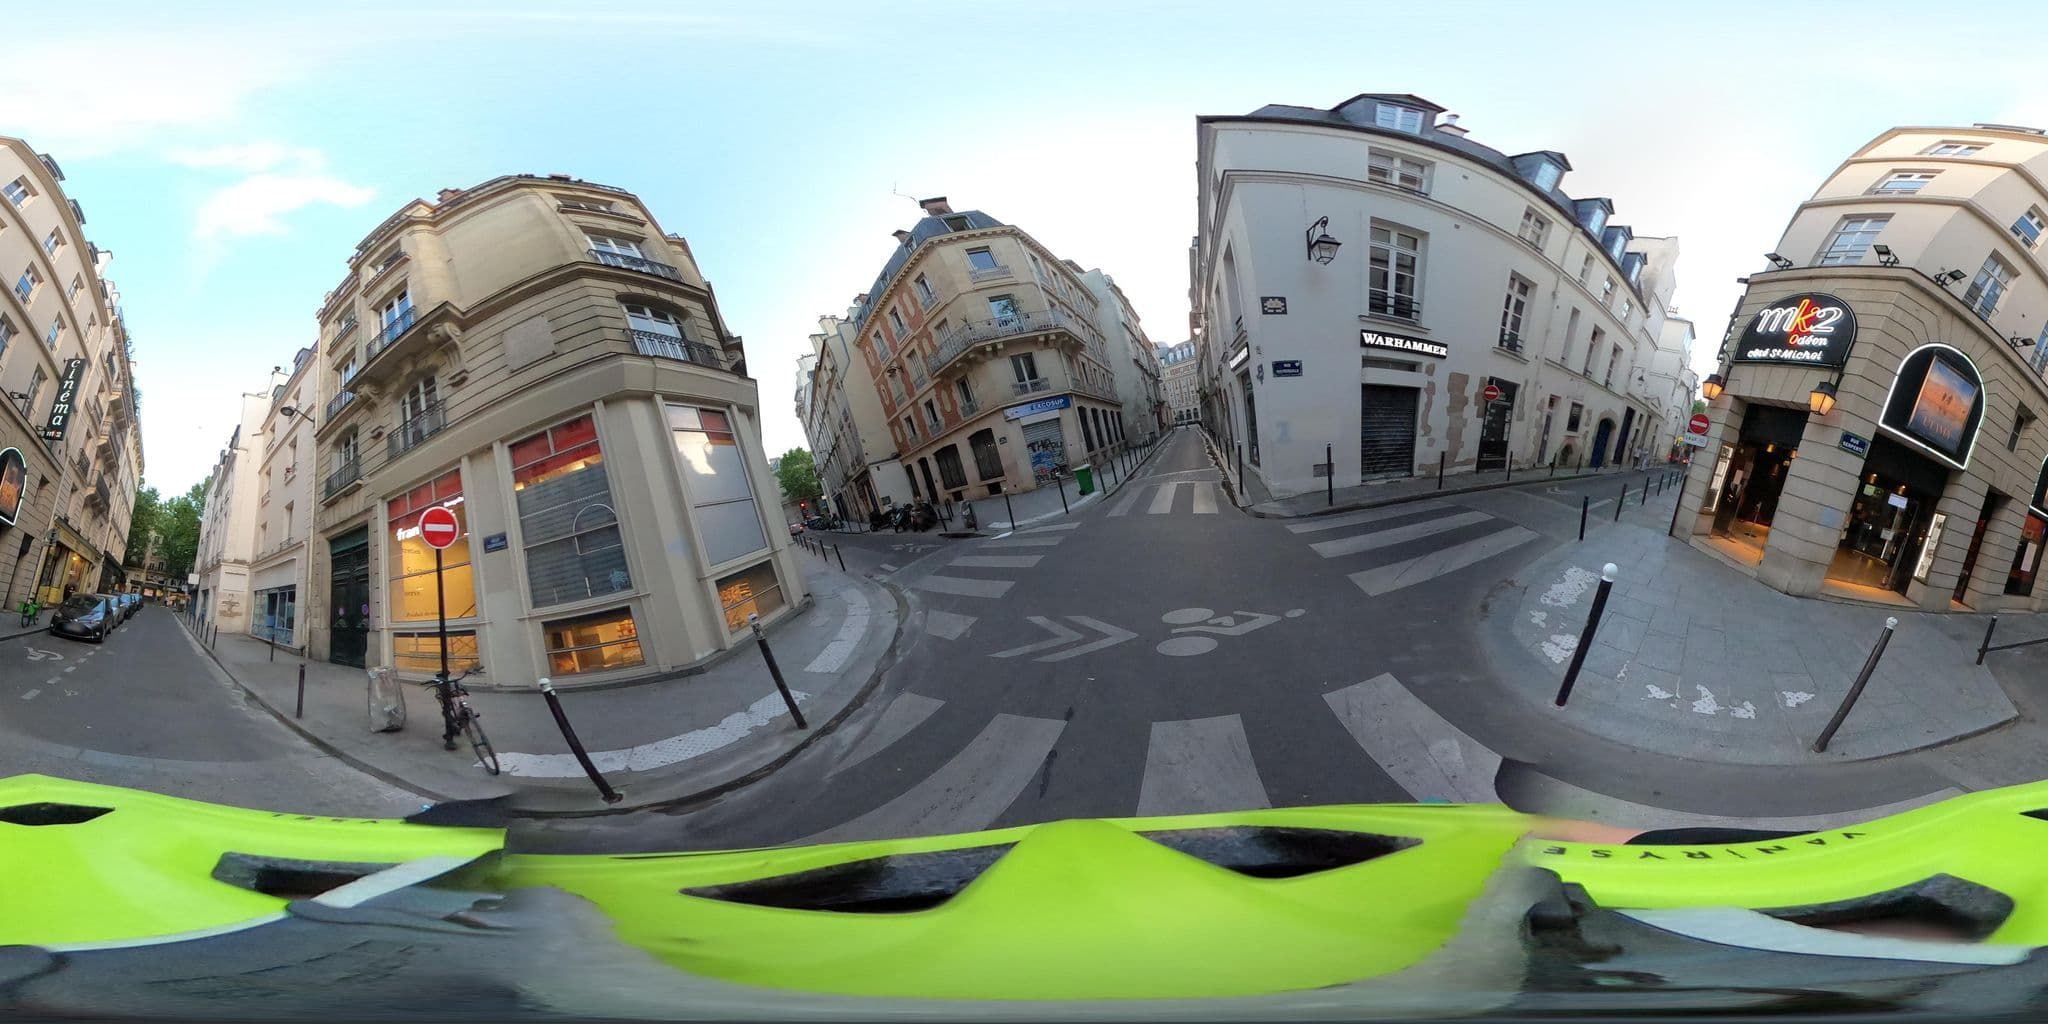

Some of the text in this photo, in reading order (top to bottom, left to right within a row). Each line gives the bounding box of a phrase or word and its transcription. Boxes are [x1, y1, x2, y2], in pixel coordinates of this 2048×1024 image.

[1756, 299, 1843, 333] mk2
[1362, 332, 1447, 356] WARHAMMER
[1789, 334, 1828, 346] Odéon
[1780, 350, 1823, 361] Michel
[52, 359, 81, 426] cinéma
